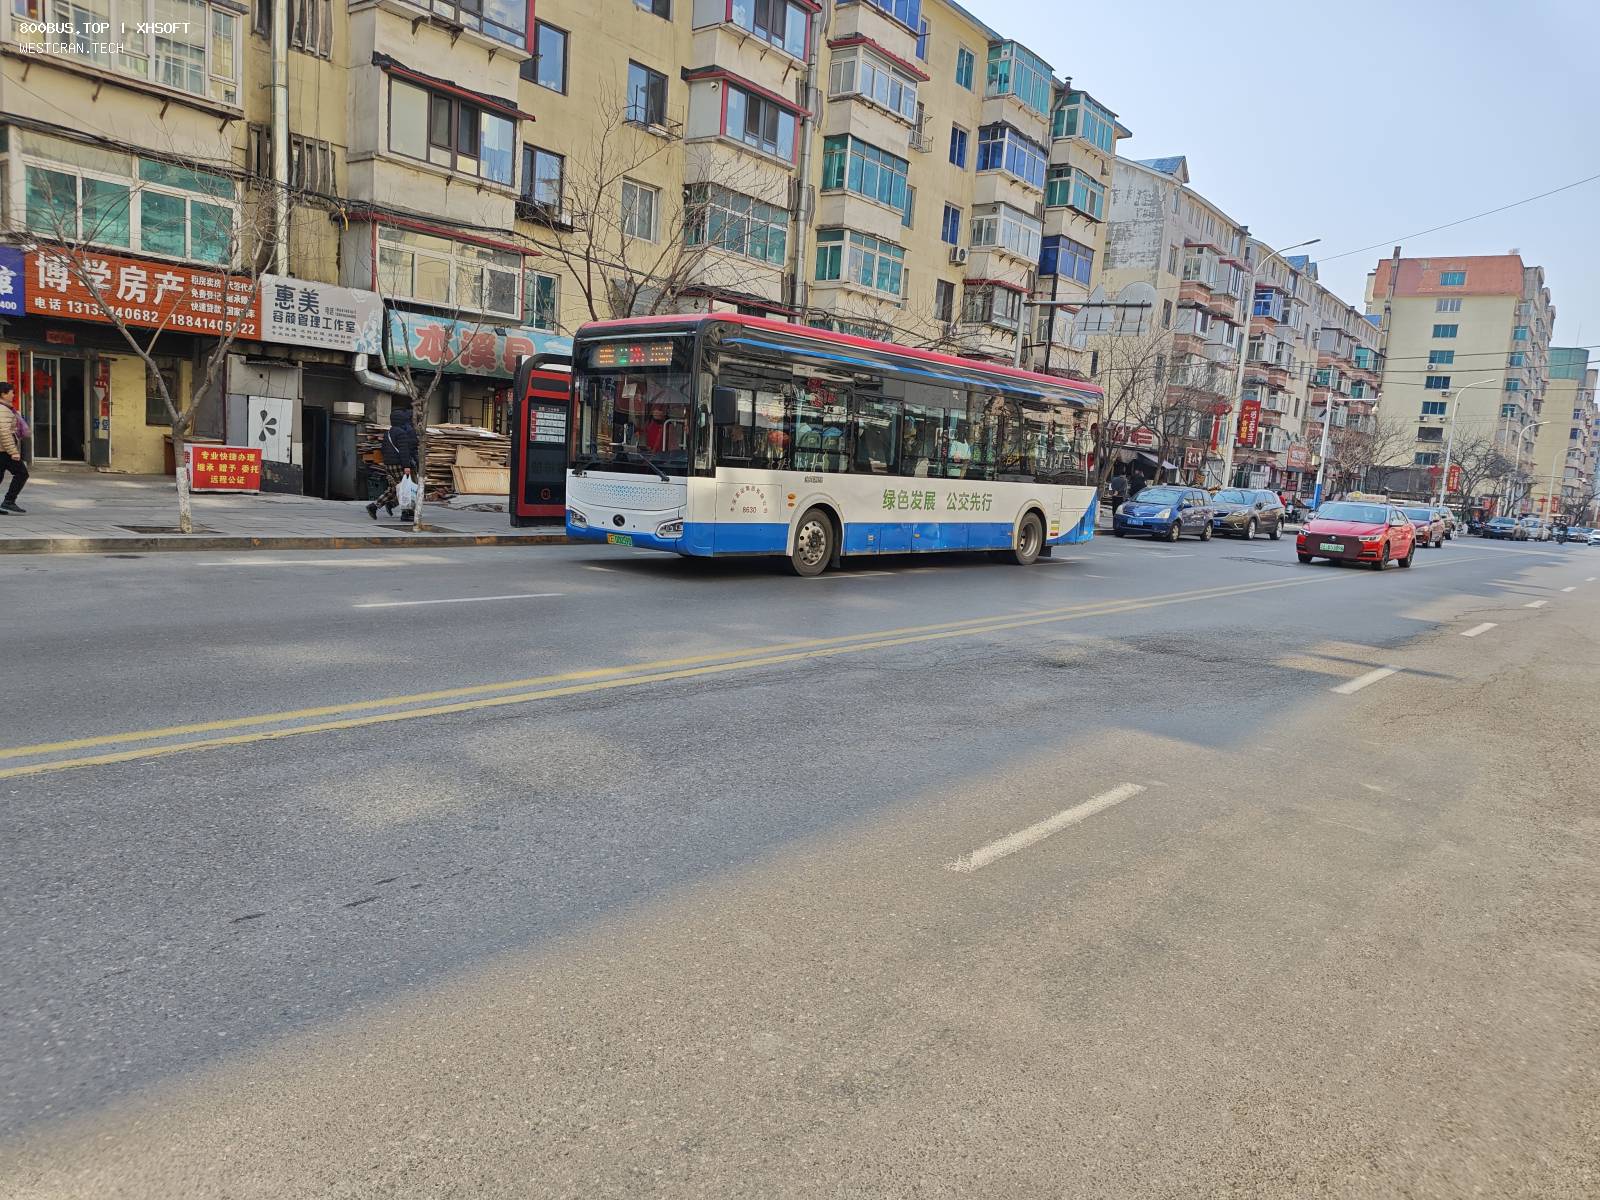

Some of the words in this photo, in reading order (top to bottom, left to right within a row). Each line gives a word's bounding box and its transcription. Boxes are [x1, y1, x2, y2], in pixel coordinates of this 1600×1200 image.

[34, 250, 185, 305] 博学房产
[274, 284, 320, 315] 惠美
[34, 296, 61, 311] 电话
[67, 300, 160, 323] 131340682
[171, 313, 256, 335] 1884140522
[272, 309, 356, 334] 容颜管理工作室
[882, 489, 936, 511] 绿色发展
[946, 491, 993, 511] 公交先行
